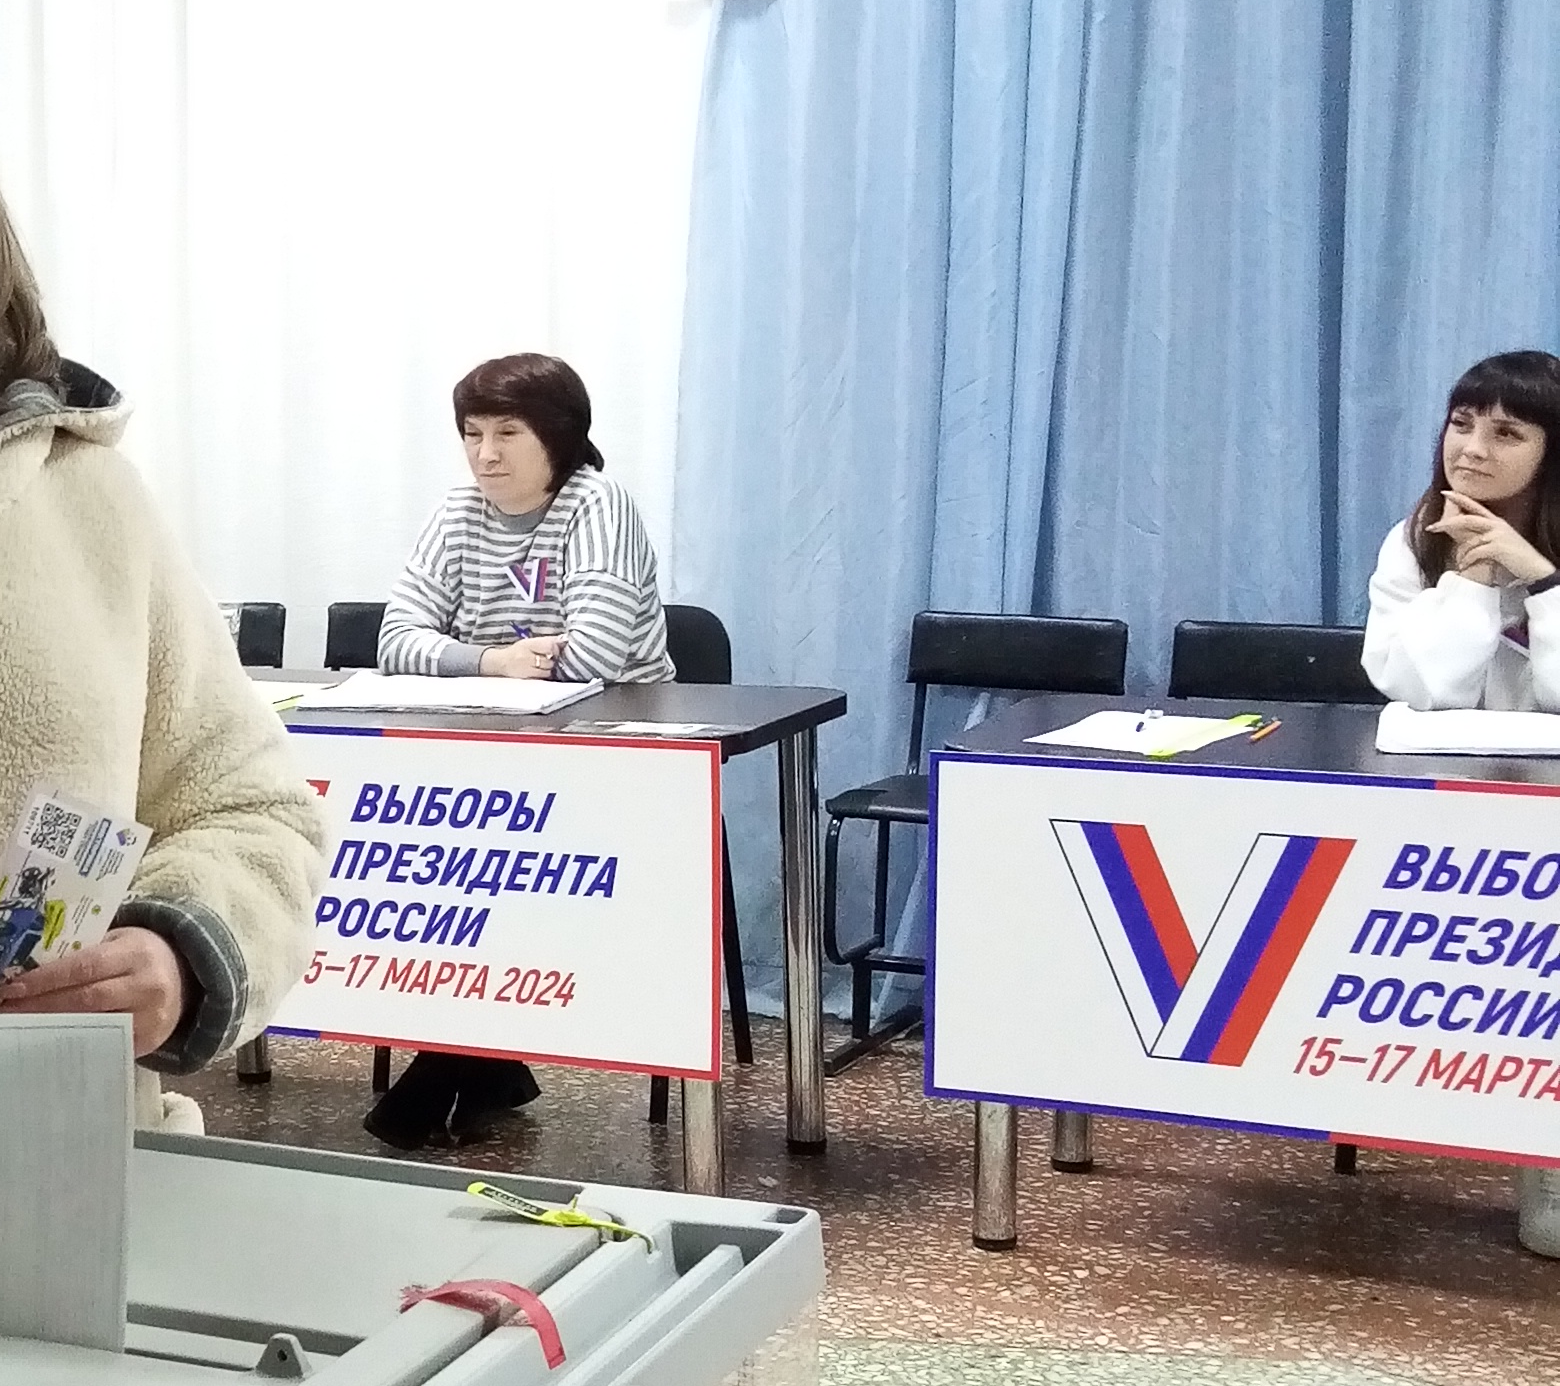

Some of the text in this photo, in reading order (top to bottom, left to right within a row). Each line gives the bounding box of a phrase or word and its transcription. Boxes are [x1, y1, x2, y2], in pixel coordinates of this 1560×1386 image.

[350, 782, 557, 834] ВЫБОРЫ
[328, 839, 620, 899] ПРЕЗИДЕНТА
[1382, 843, 1560, 901] ВЫБО
[315, 895, 492, 948] РОССИИ
[1349, 908, 1560, 979] ПРЕЗИ
[303, 950, 577, 1009] 5–17 МАРТА 2024
[1315, 973, 1560, 1041] РОССИИ
[1414, 1047, 1560, 1102] МАРТА
